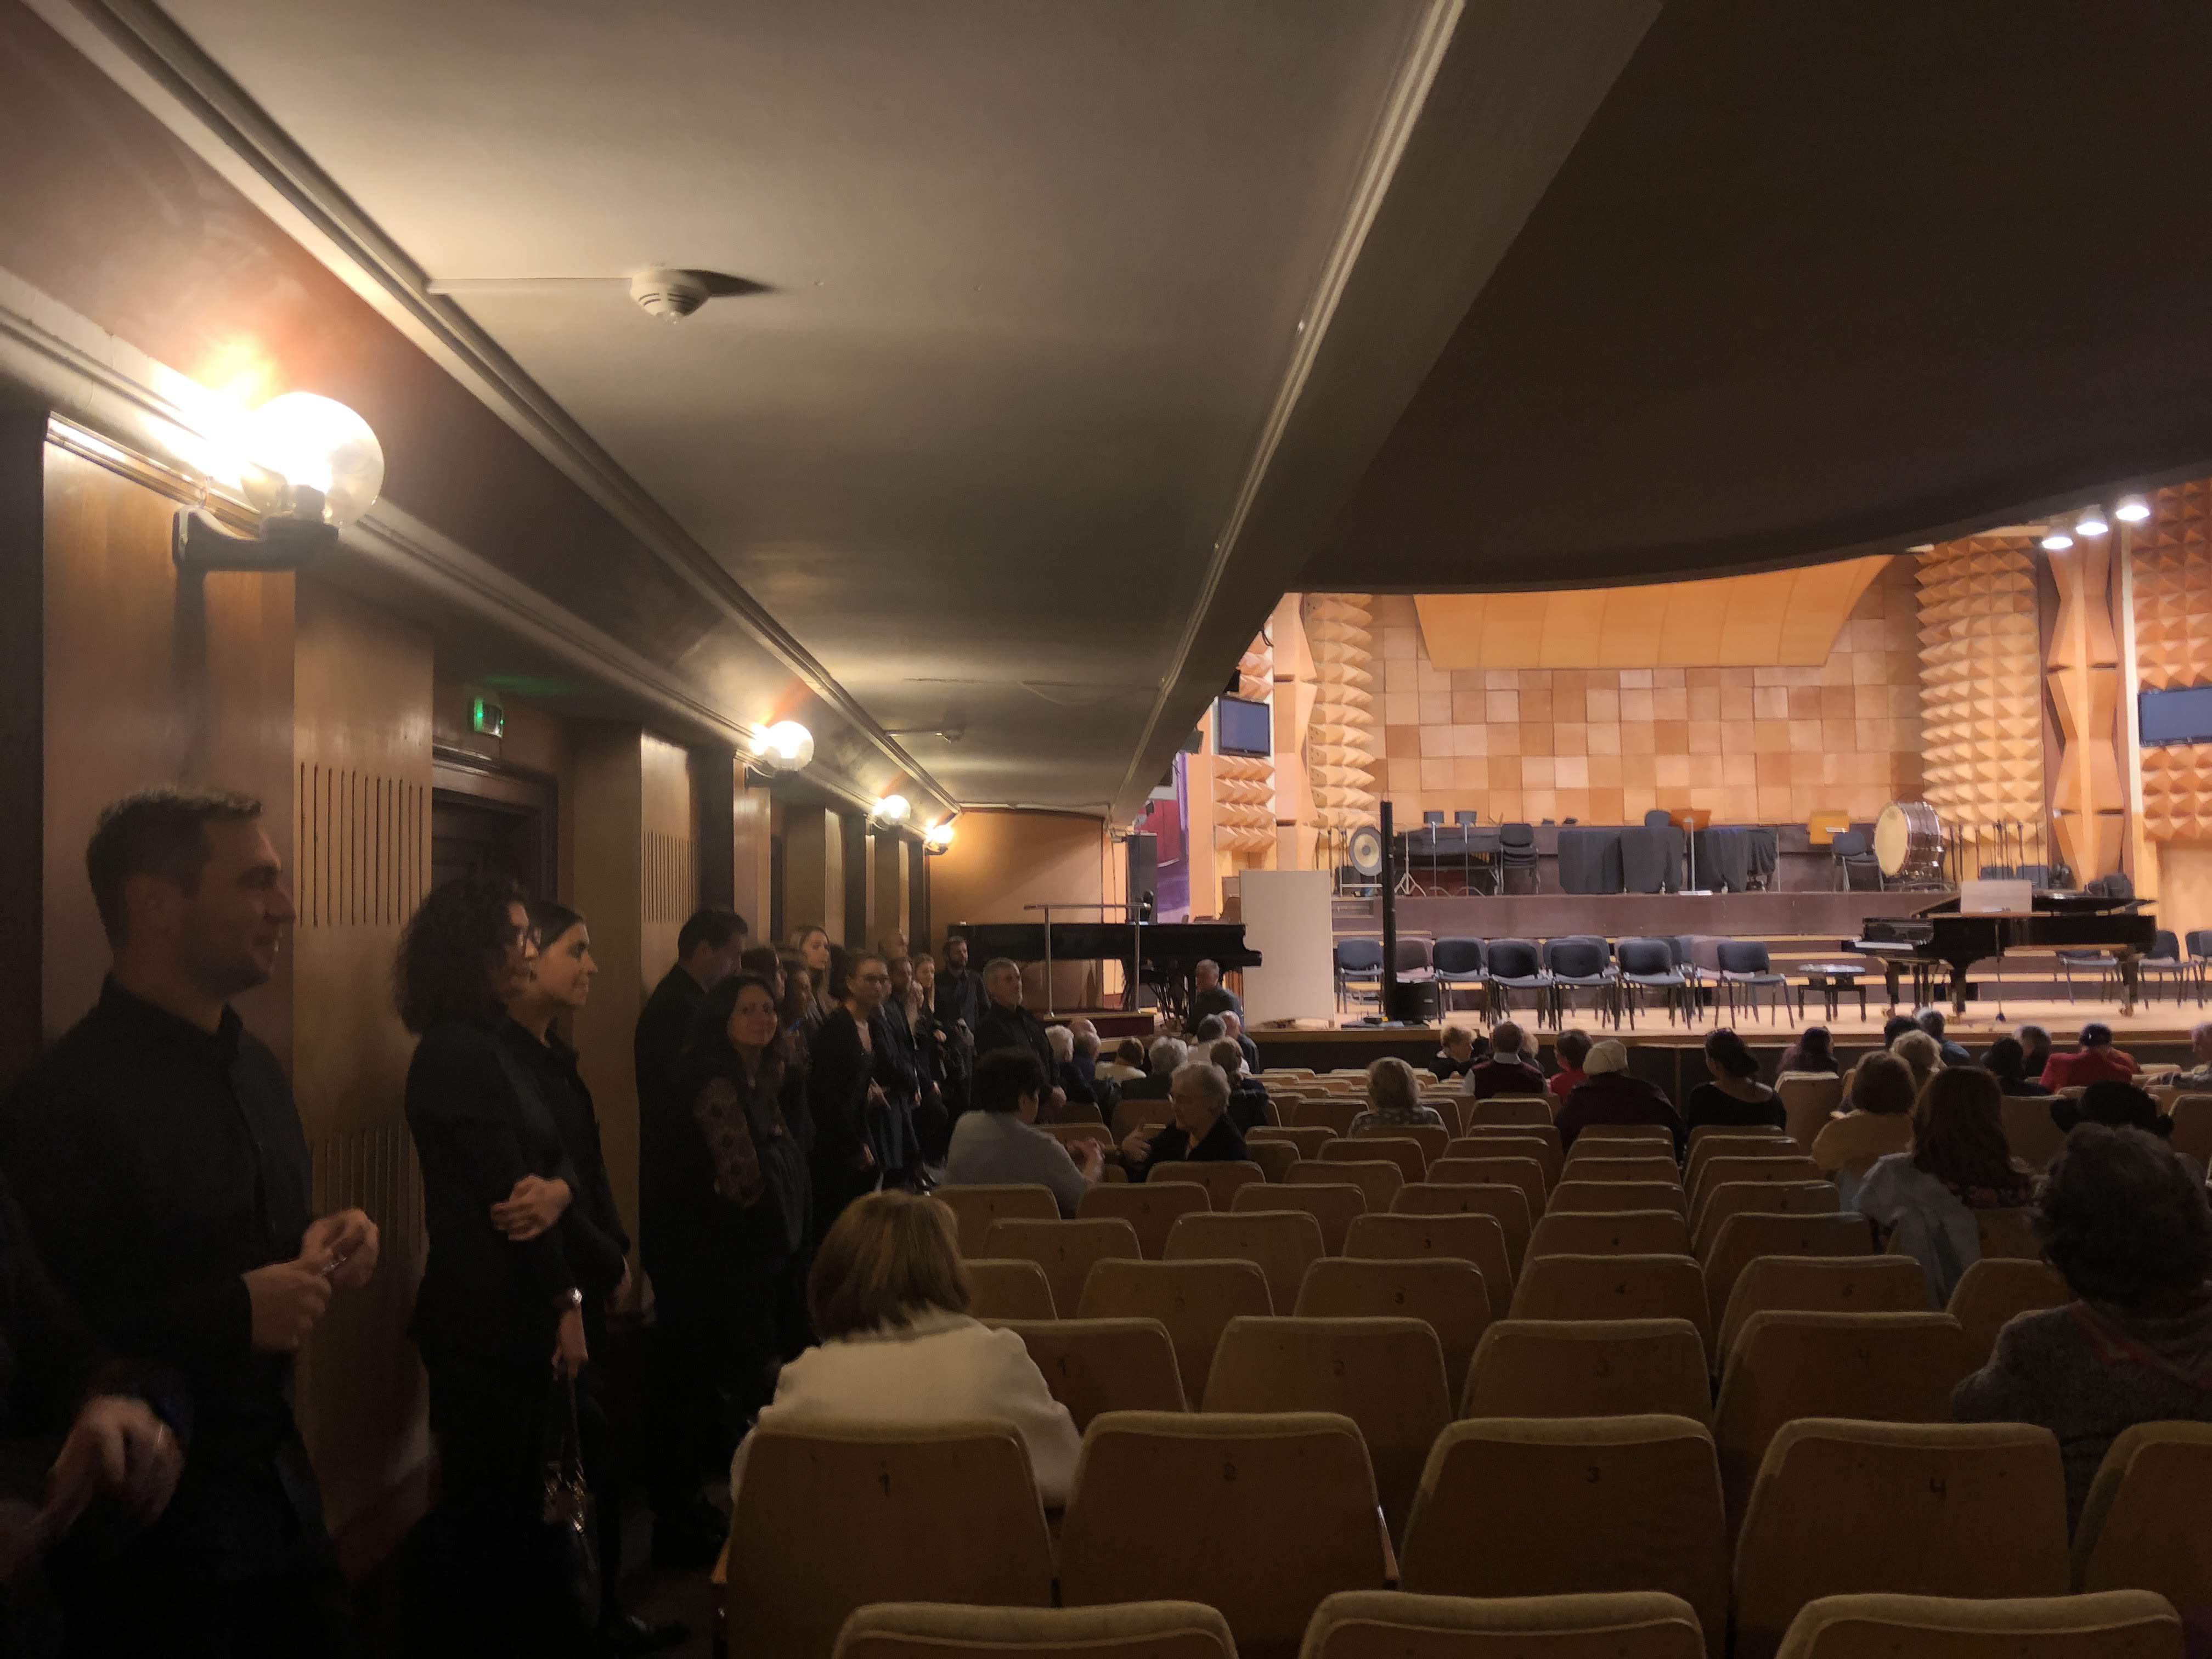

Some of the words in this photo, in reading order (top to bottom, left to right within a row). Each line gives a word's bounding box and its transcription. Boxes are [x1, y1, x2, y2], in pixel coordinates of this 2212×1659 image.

[878, 1472, 891, 1496] 1
[1587, 1465, 1600, 1483] 3
[1929, 1476, 1947, 1499] 4
